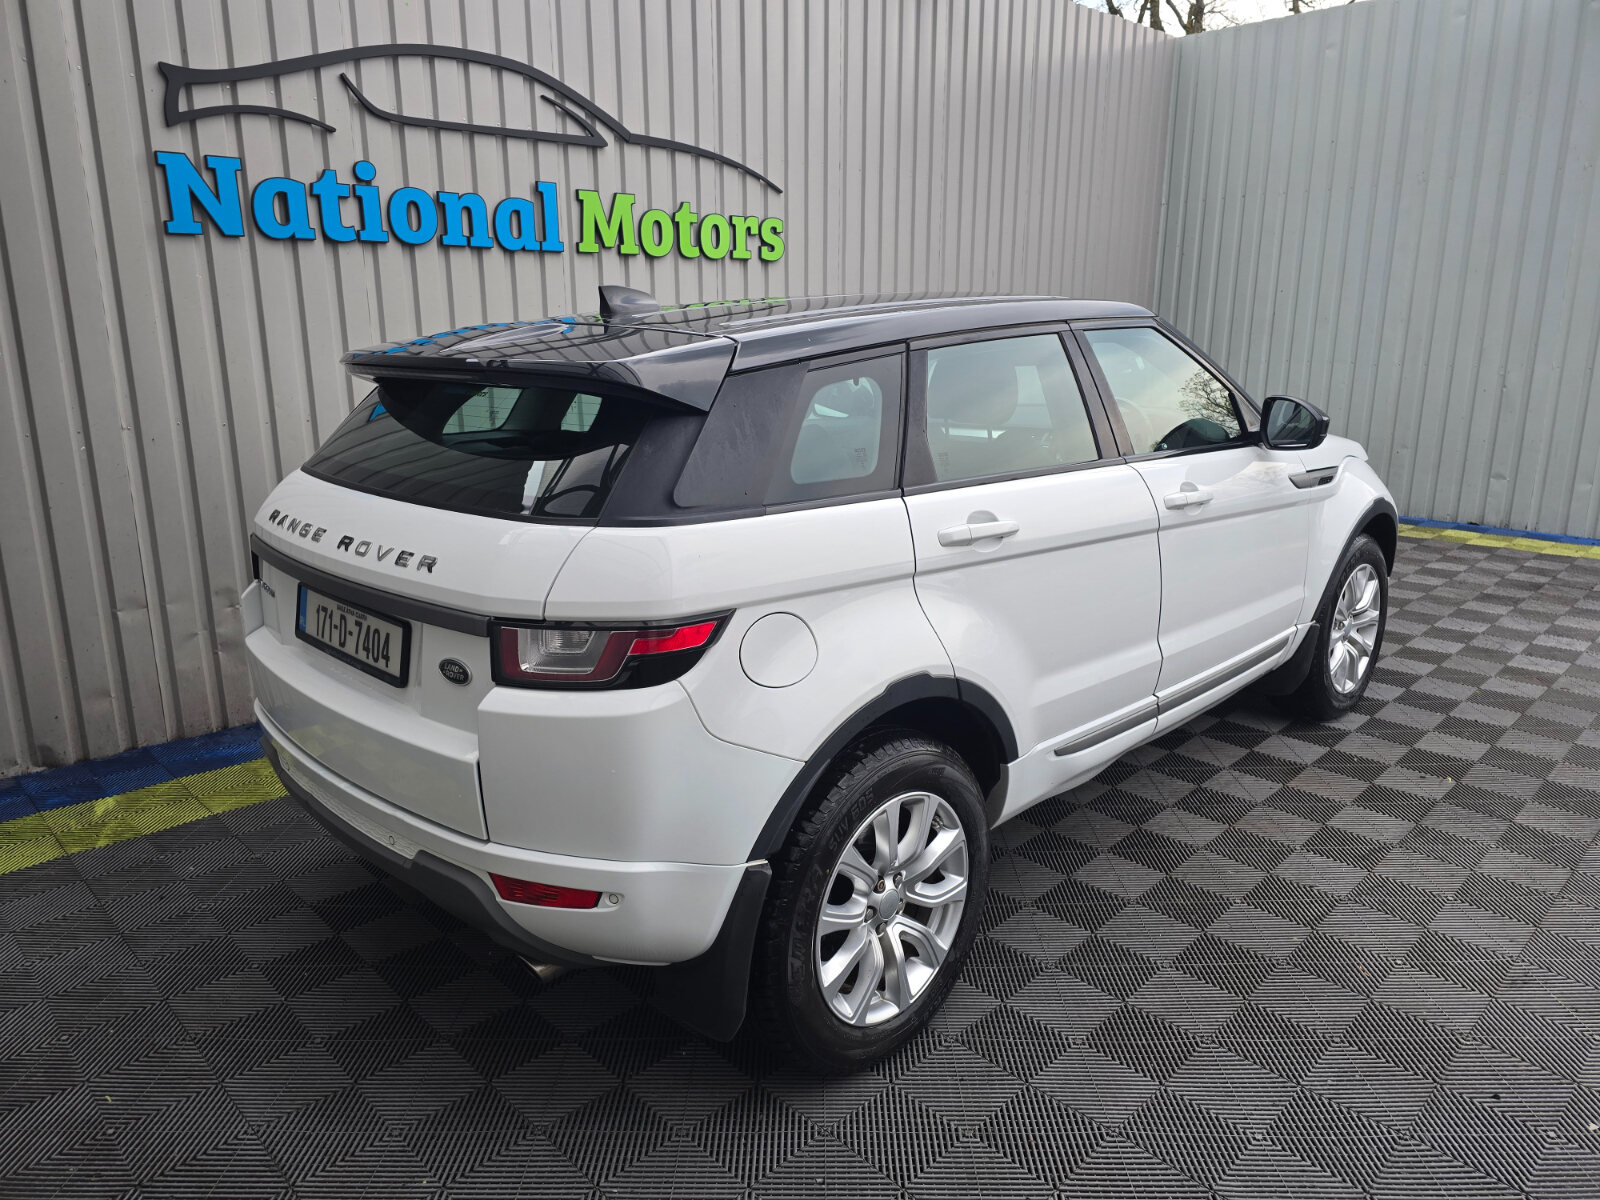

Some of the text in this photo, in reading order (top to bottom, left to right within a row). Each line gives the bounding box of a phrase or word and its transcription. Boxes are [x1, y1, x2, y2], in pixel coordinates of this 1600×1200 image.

[154, 150, 785, 262] National Motors
[268, 508, 439, 574] RANGE ROVER
[315, 604, 391, 669] 171-D-7404
[444, 662, 460, 673] LAND
[445, 670, 465, 681] ROVER
